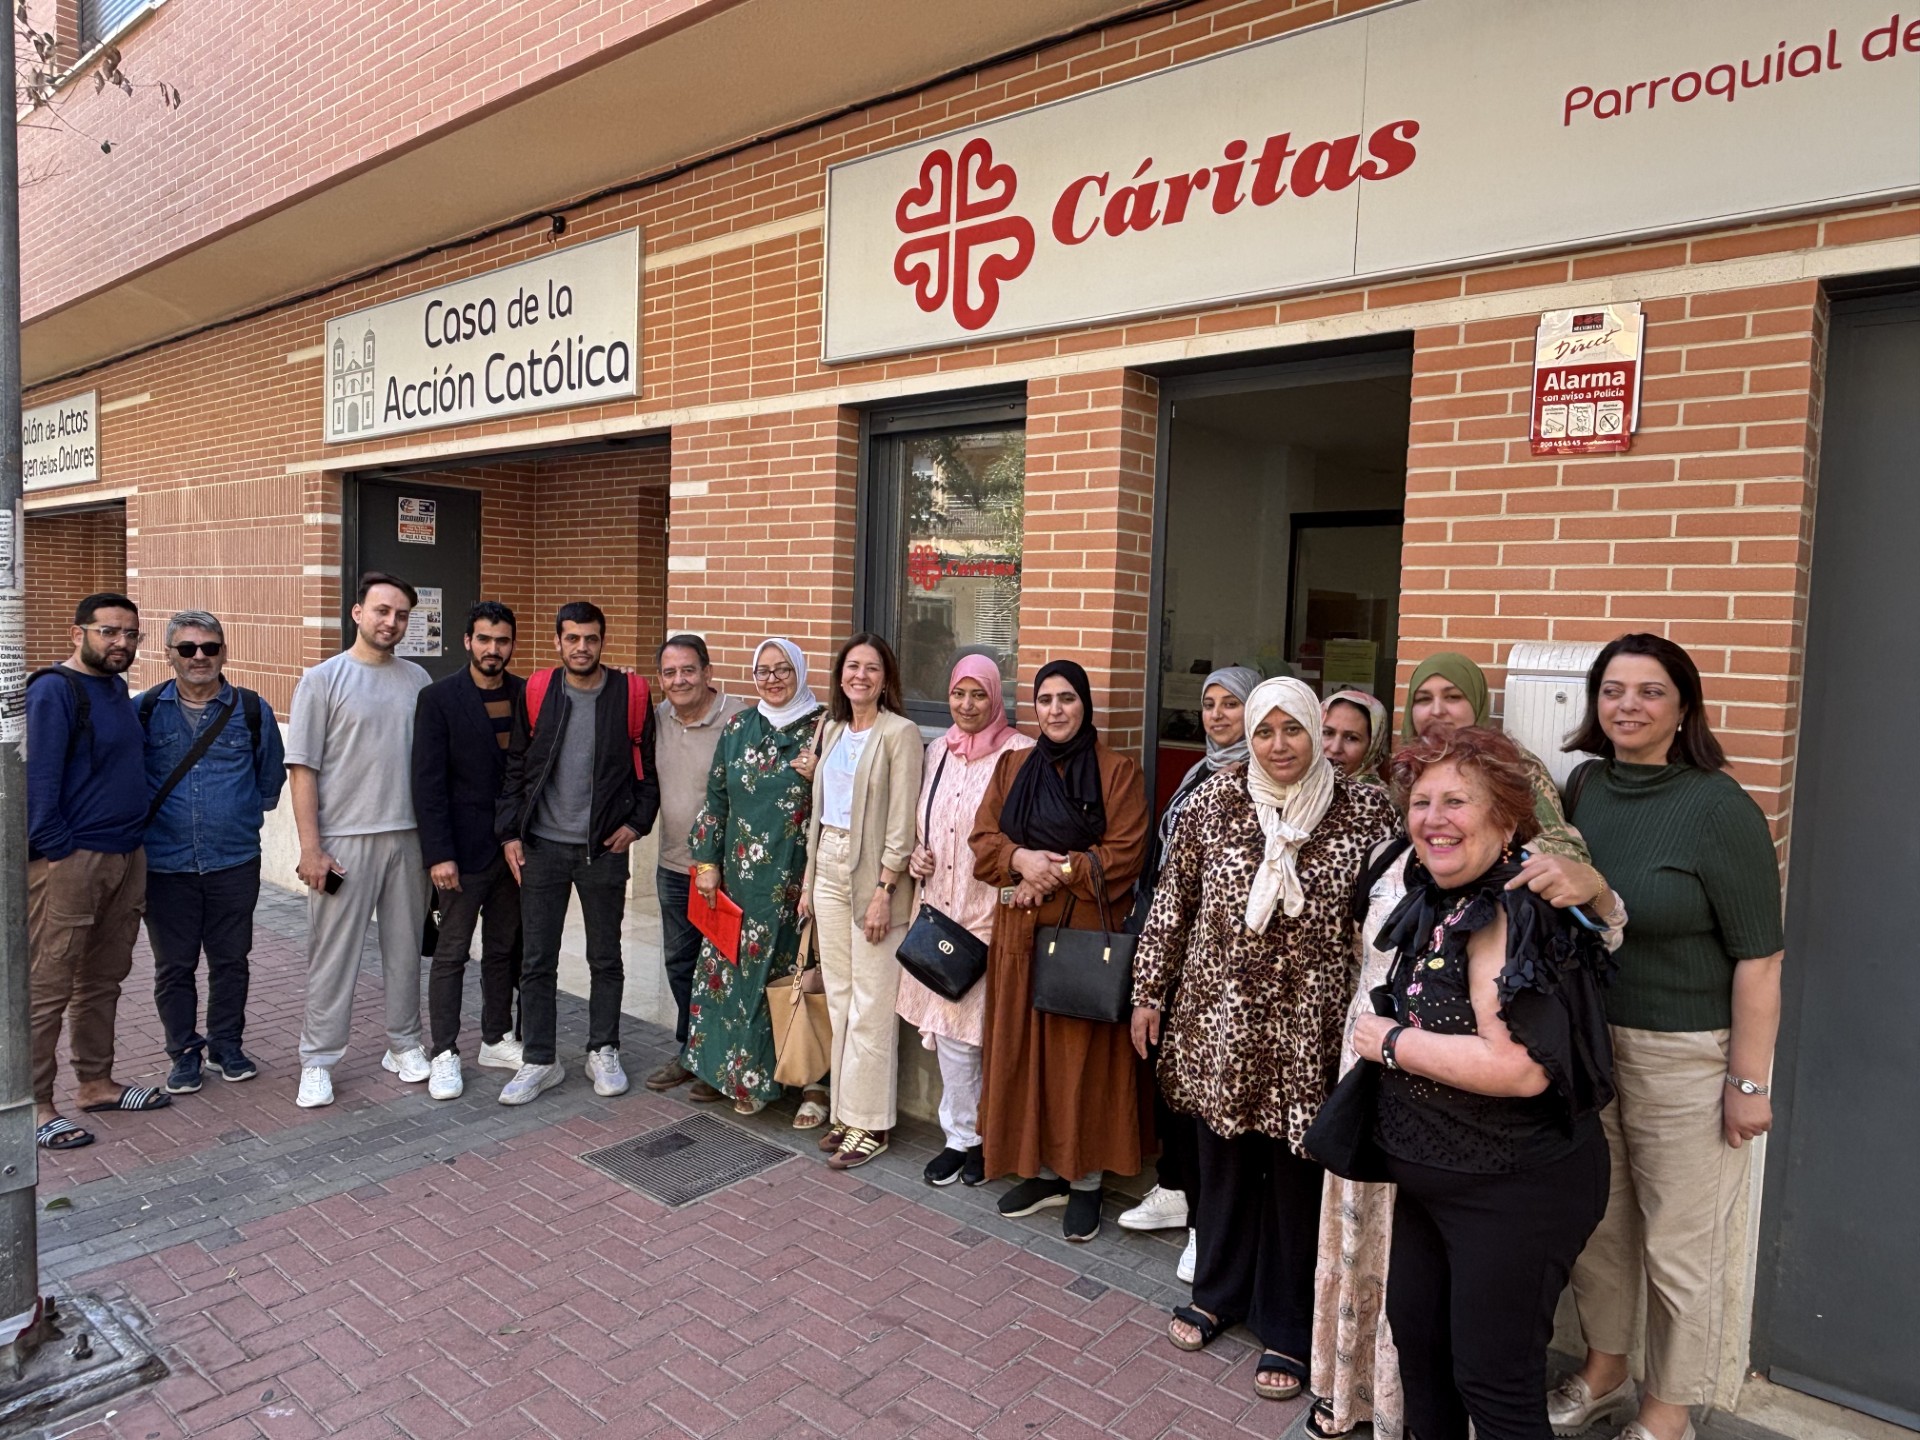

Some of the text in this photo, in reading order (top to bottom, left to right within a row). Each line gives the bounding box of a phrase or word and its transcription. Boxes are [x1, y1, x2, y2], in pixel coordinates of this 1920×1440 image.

[1564, 14, 1920, 126] Parroquial de
[1051, 119, 1420, 246] Cáritas
[424, 279, 573, 348] Casa de la
[1554, 328, 1622, 360] Direct
[383, 334, 630, 423] Acción Católica
[1543, 370, 1626, 391] Alarma
[1560, 391, 1584, 401] aviso
[1594, 389, 1625, 399] Policía
[46, 420, 55, 440] de
[58, 408, 88, 438] Actos
[39, 456, 47, 475] de
[59, 444, 94, 472] Dolores
